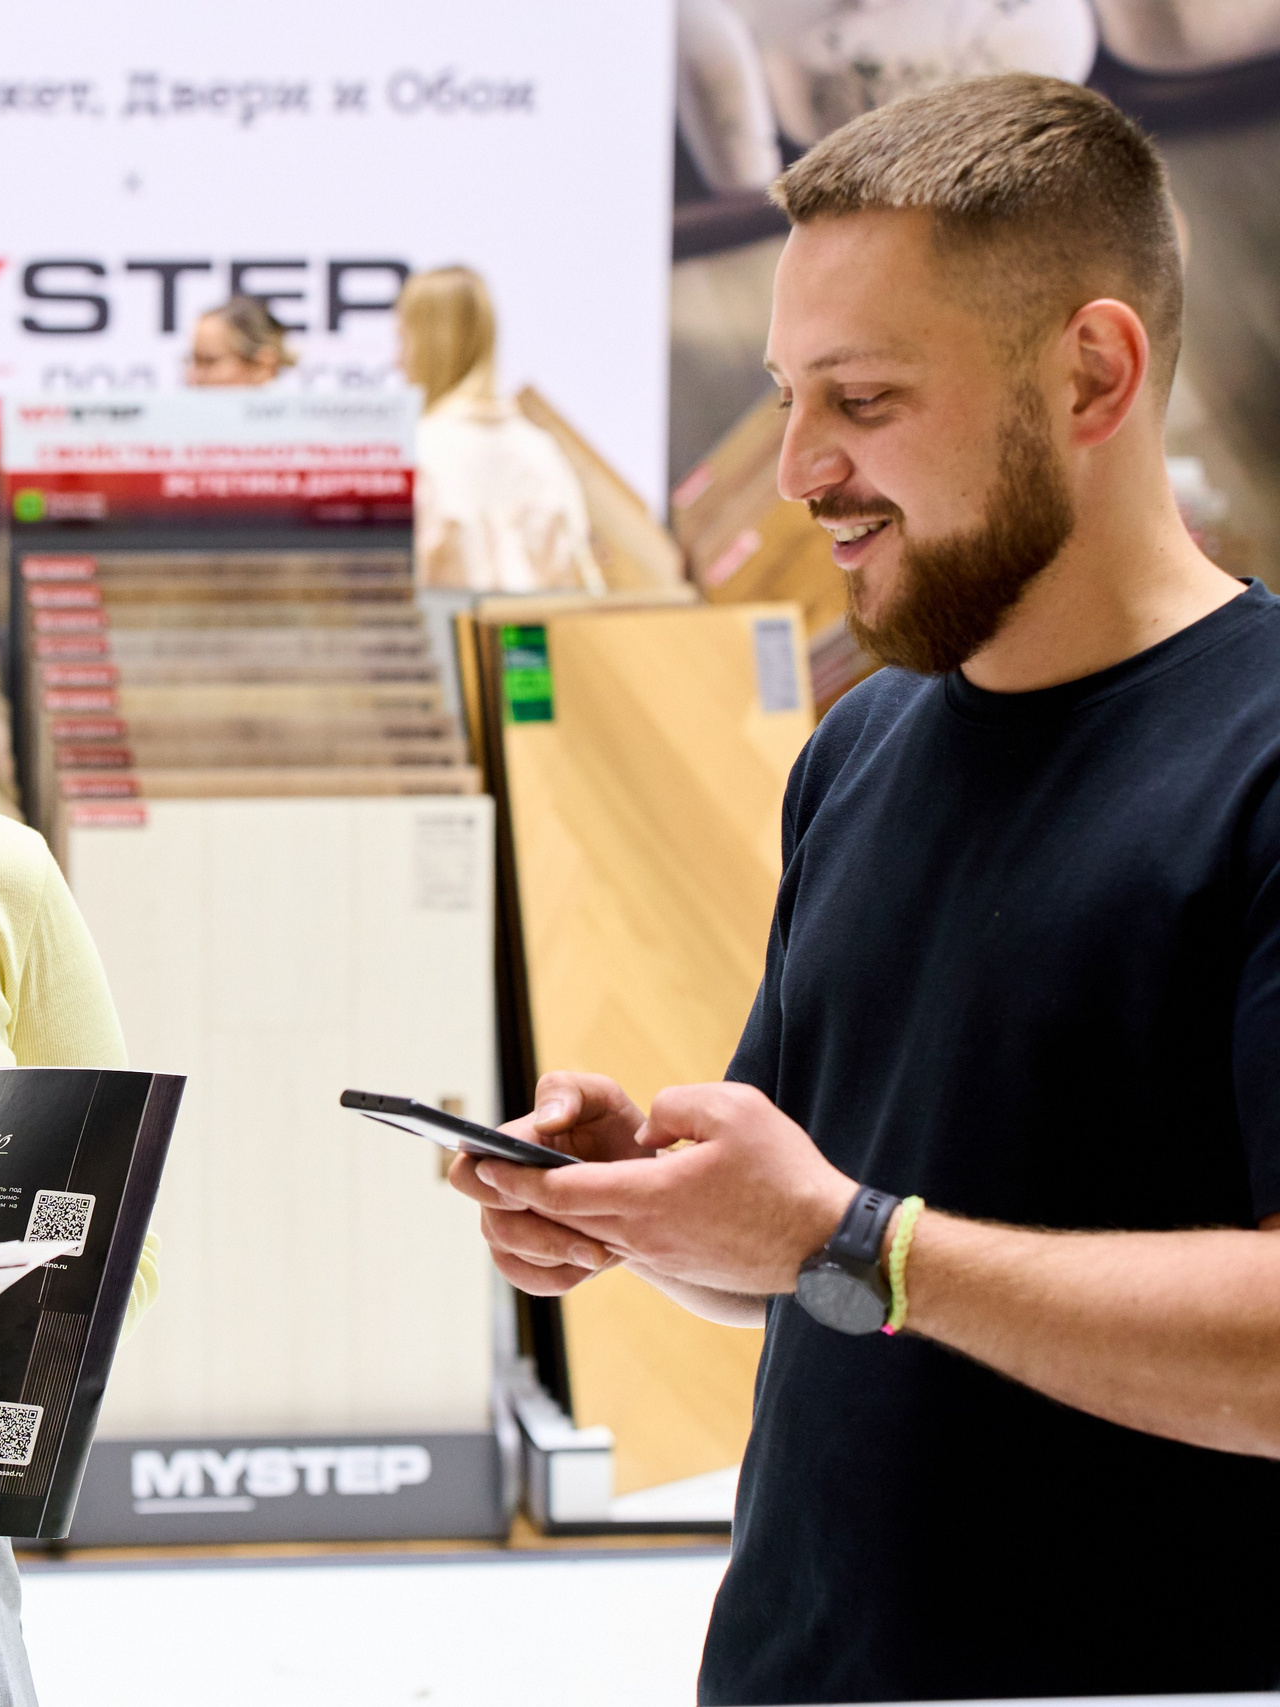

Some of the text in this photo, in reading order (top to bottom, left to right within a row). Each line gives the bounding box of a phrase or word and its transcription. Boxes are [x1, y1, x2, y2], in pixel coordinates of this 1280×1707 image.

[123, 72, 309, 128] Двери
[332, 82, 366, 114] и
[388, 66, 534, 115] Обои
[130, 1445, 432, 1499] MYSTEP
